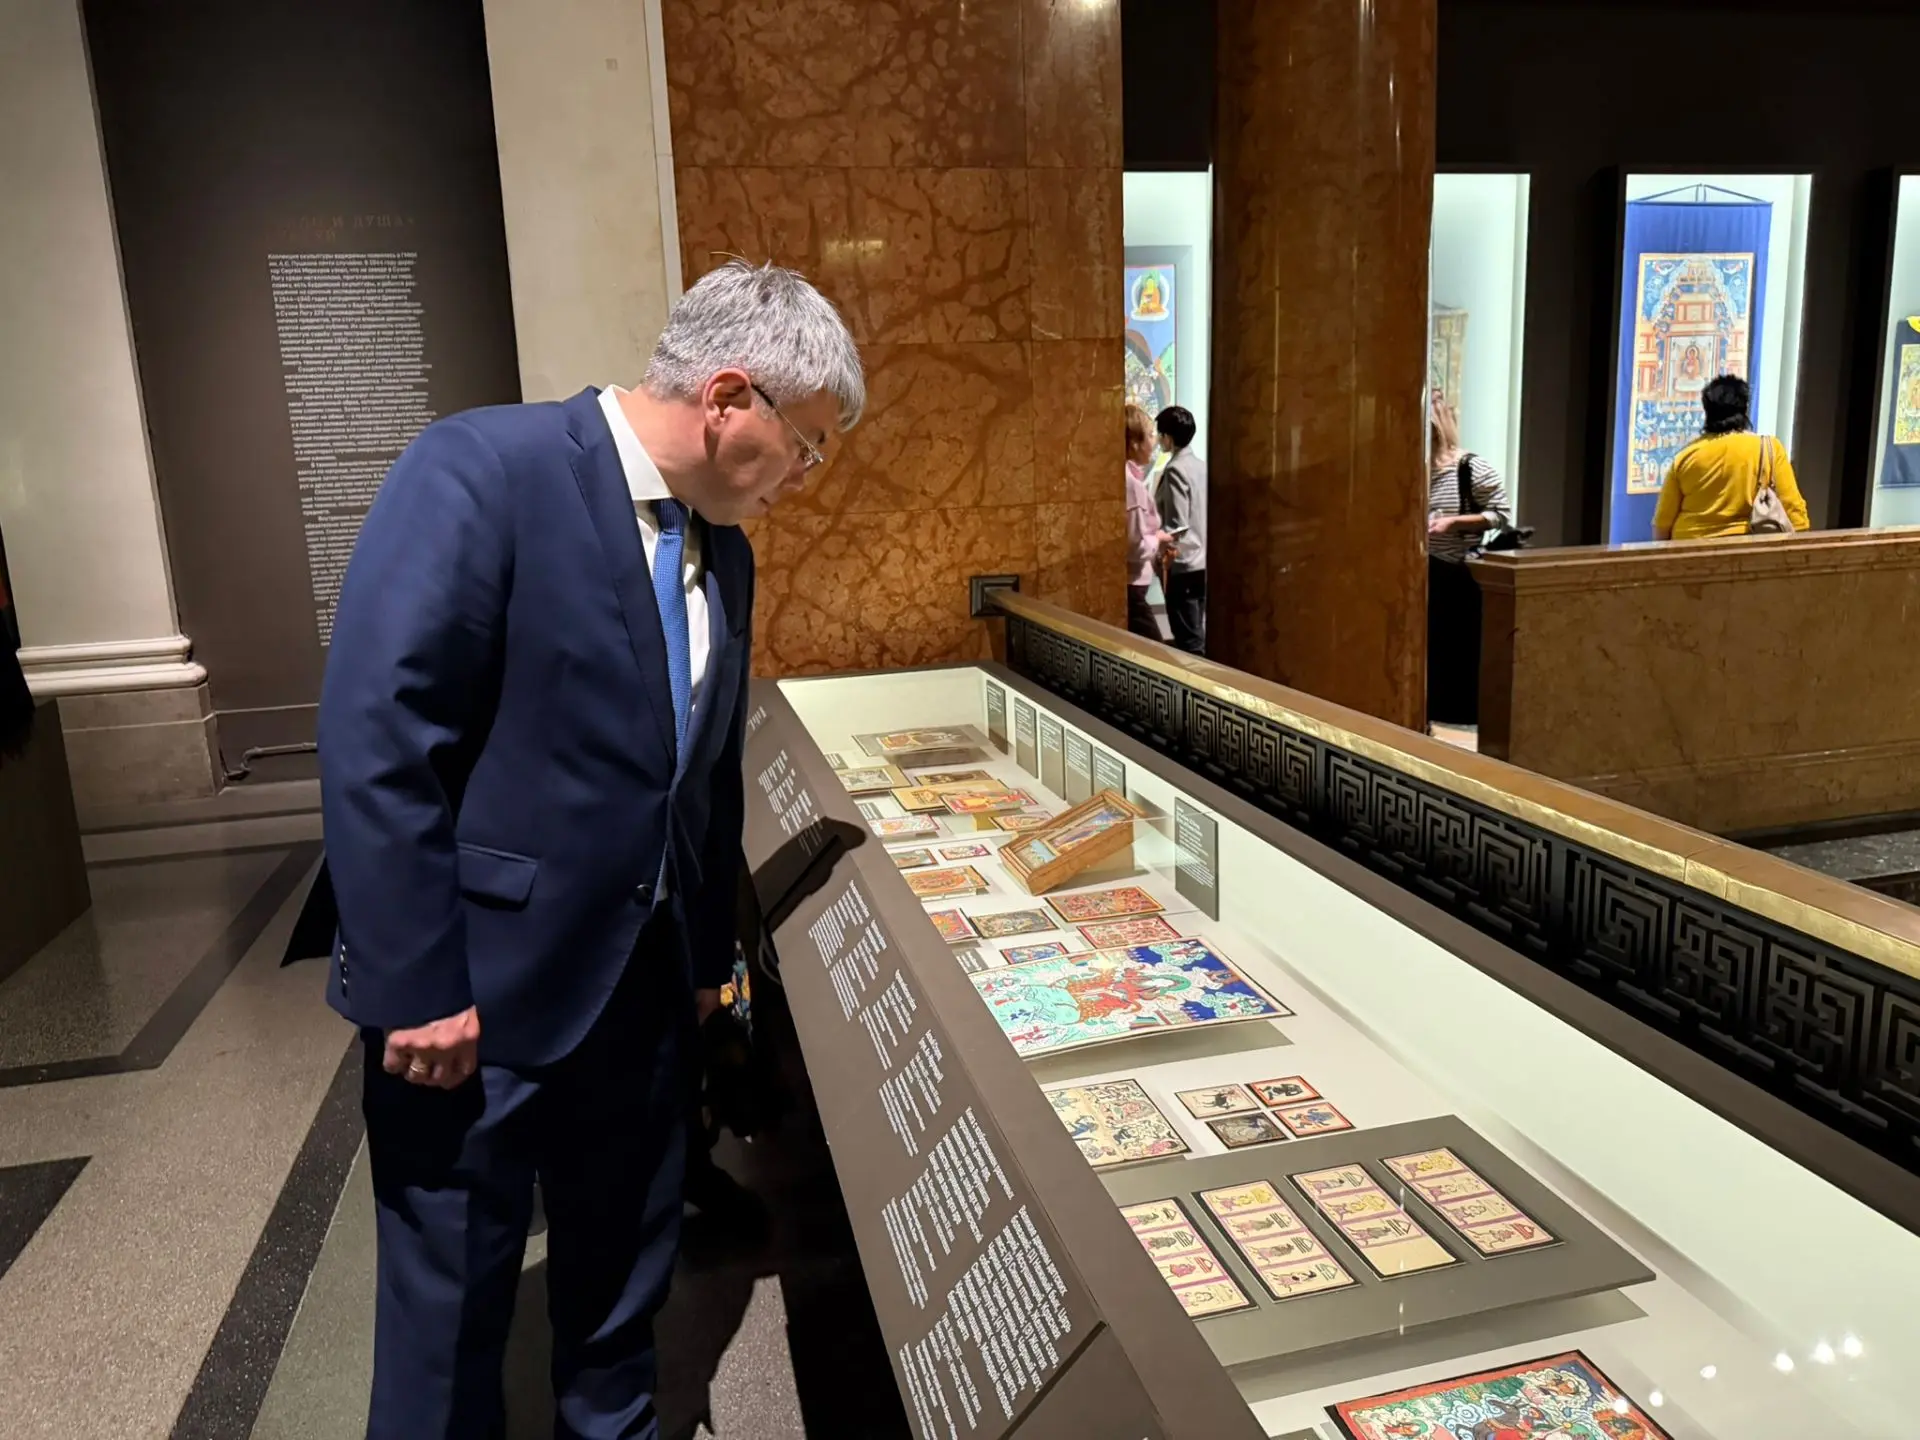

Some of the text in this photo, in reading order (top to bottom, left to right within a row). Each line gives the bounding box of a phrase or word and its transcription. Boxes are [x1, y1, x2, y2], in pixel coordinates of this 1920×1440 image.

[1019, 1205, 1037, 1237] Великие
[1047, 1262, 1067, 1297] детских
[955, 1317, 970, 1341] цвета
[1017, 1286, 1034, 1314] птица,
[1030, 1310, 1049, 1344] Желтая
[1044, 1342, 1059, 1369] сова,
[1040, 1301, 1062, 1340] Красная
[1047, 1290, 1061, 1313] бык,
[1056, 1307, 1073, 1335] Царь
[975, 1305, 994, 1339] человек
[1000, 1369, 1019, 1401] цвета,
[1028, 1334, 1048, 1370] Желтая
[1010, 1359, 1028, 1390] птица,
[1028, 1370, 1043, 1393] кот,
[992, 1381, 1015, 1420] человек
